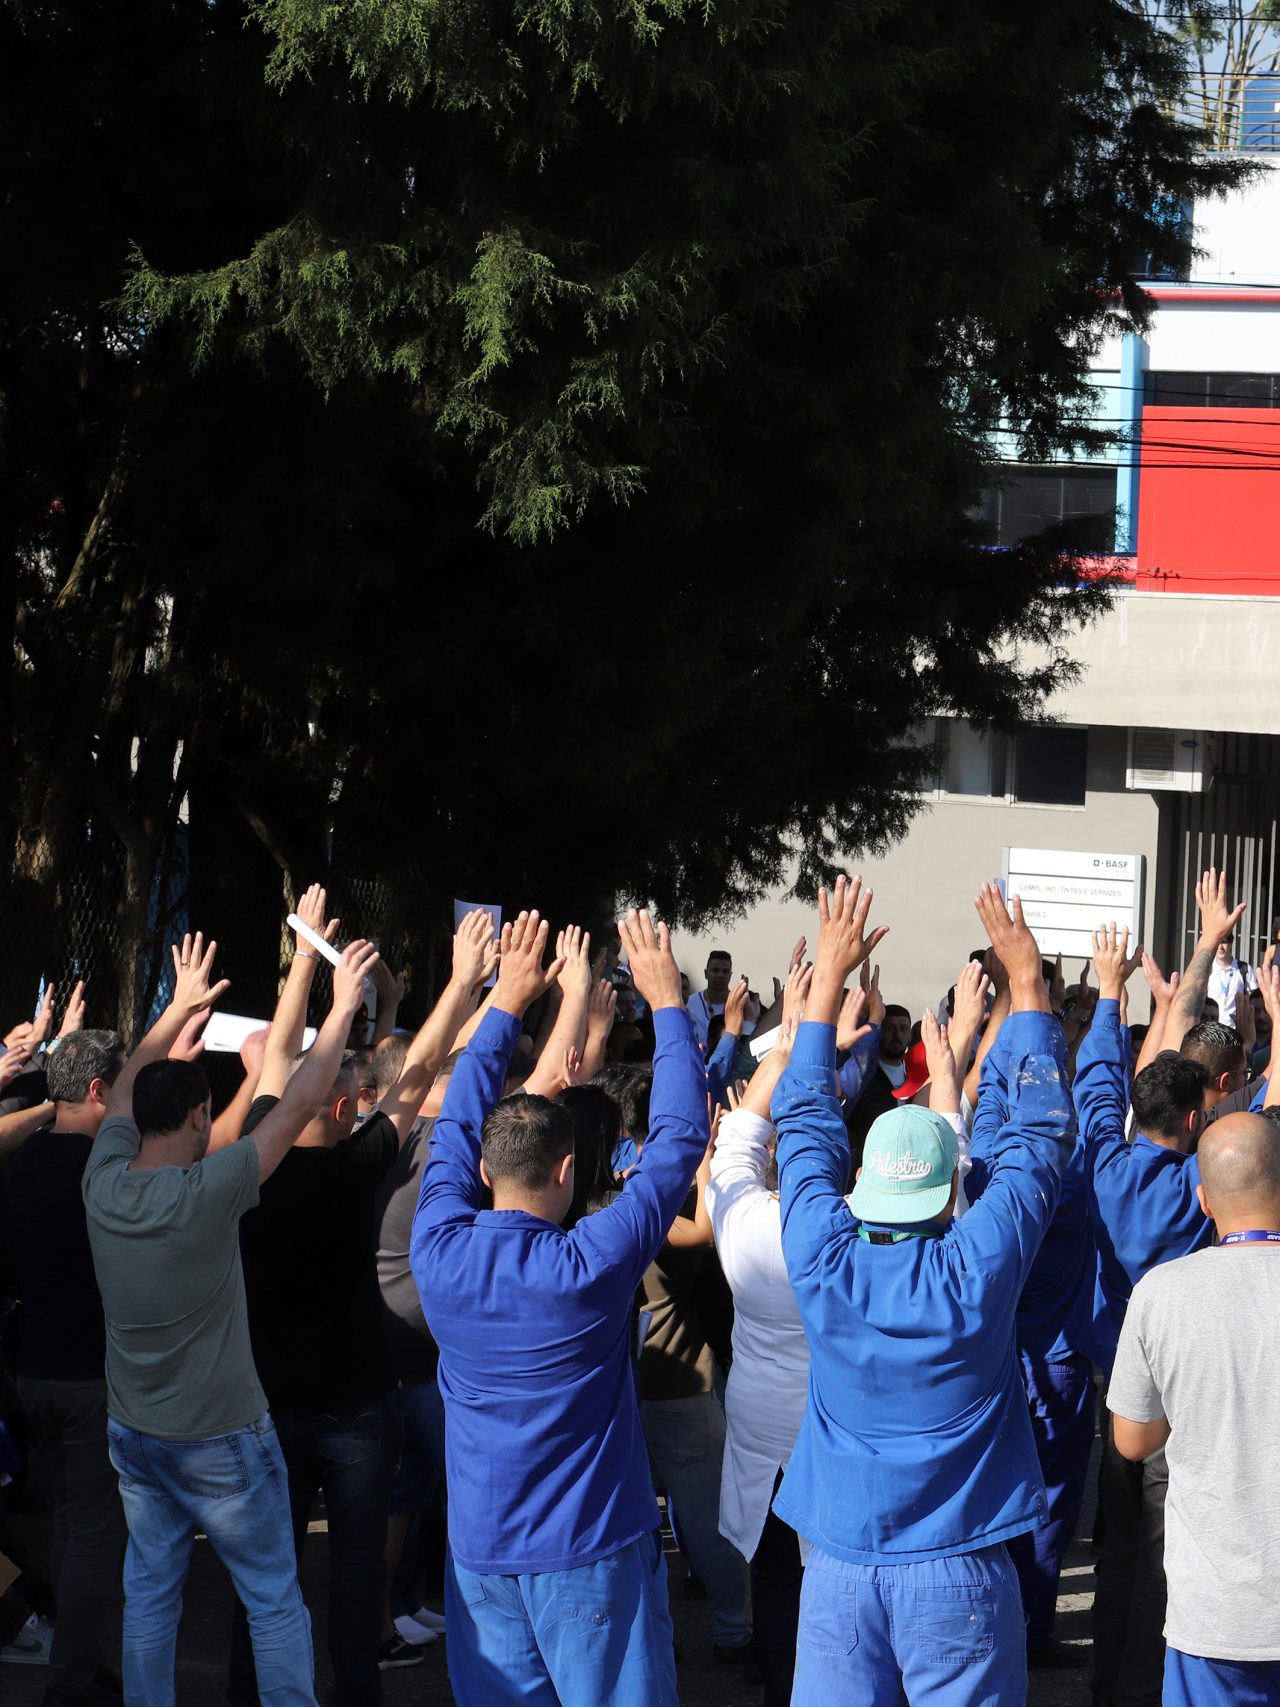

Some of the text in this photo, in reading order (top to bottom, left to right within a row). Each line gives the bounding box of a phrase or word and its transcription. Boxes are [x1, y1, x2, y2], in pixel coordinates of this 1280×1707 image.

[1105, 860, 1129, 868] BASF
[1060, 887, 1082, 895] TINTAS
[1090, 889, 1122, 897] VERNIZES
[869, 1148, 932, 1175] Palestra
